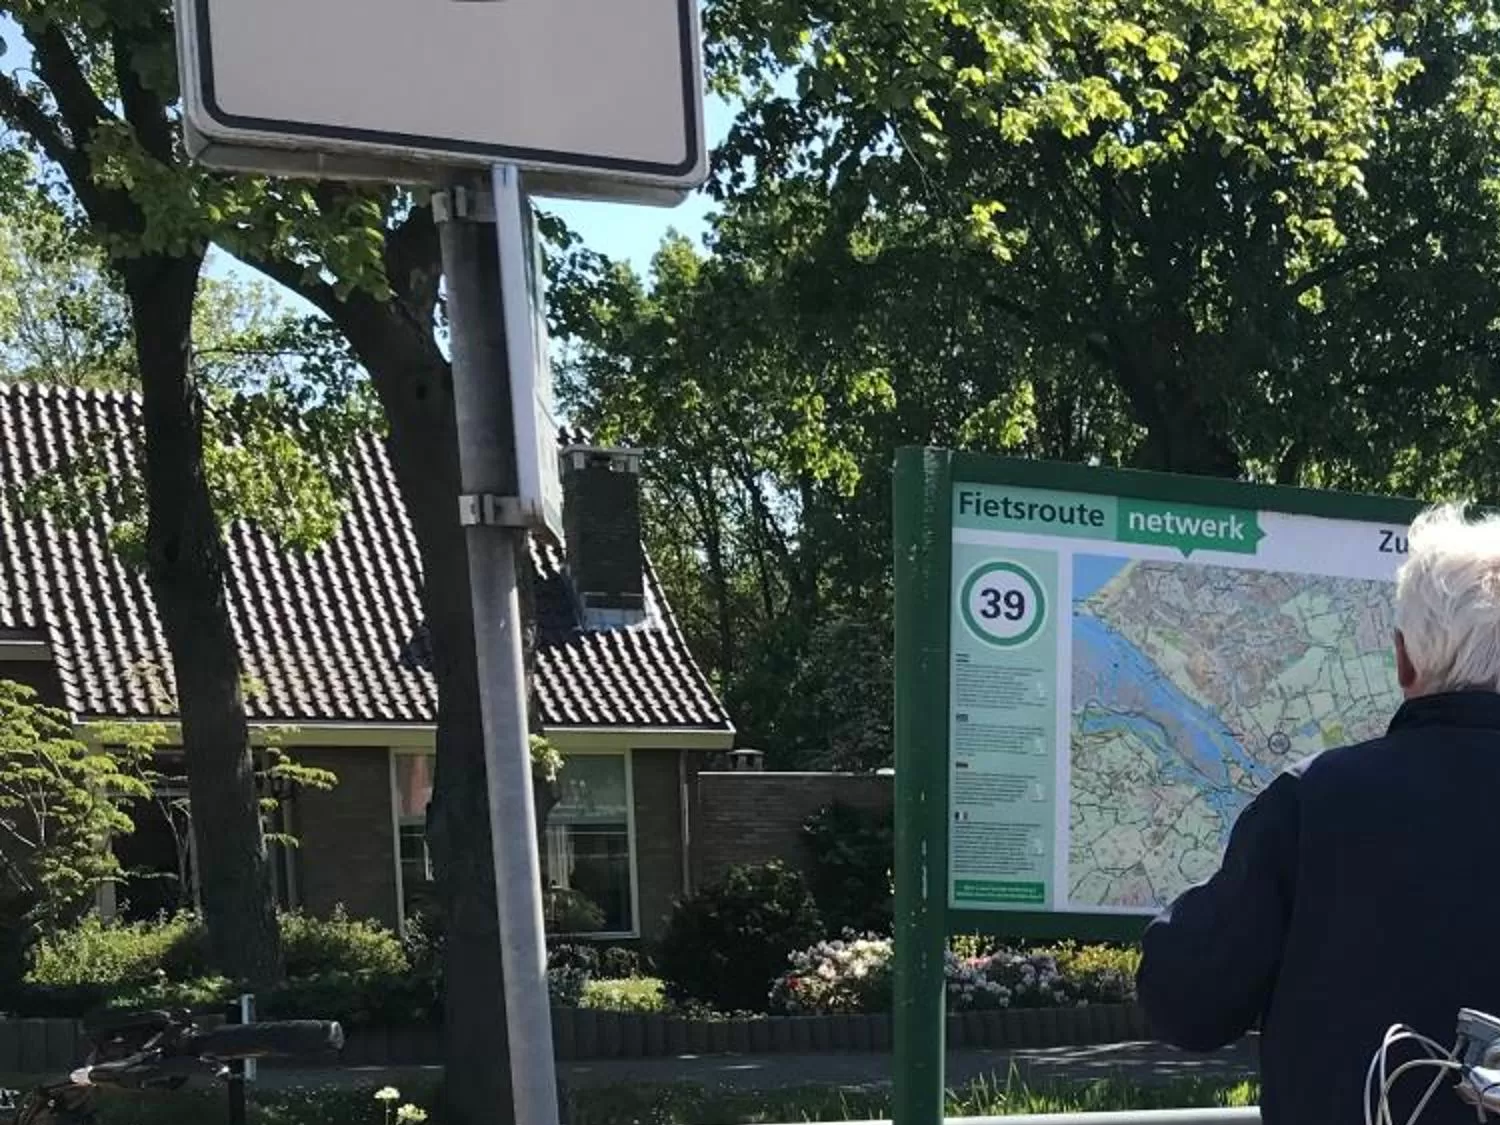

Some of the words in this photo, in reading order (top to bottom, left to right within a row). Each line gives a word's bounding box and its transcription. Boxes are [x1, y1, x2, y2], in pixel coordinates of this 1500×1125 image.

[958, 491, 1105, 527] Fietsroute
[1128, 510, 1245, 541] netwerk
[1379, 529, 1409, 555] Zu
[980, 588, 1026, 621] 39
